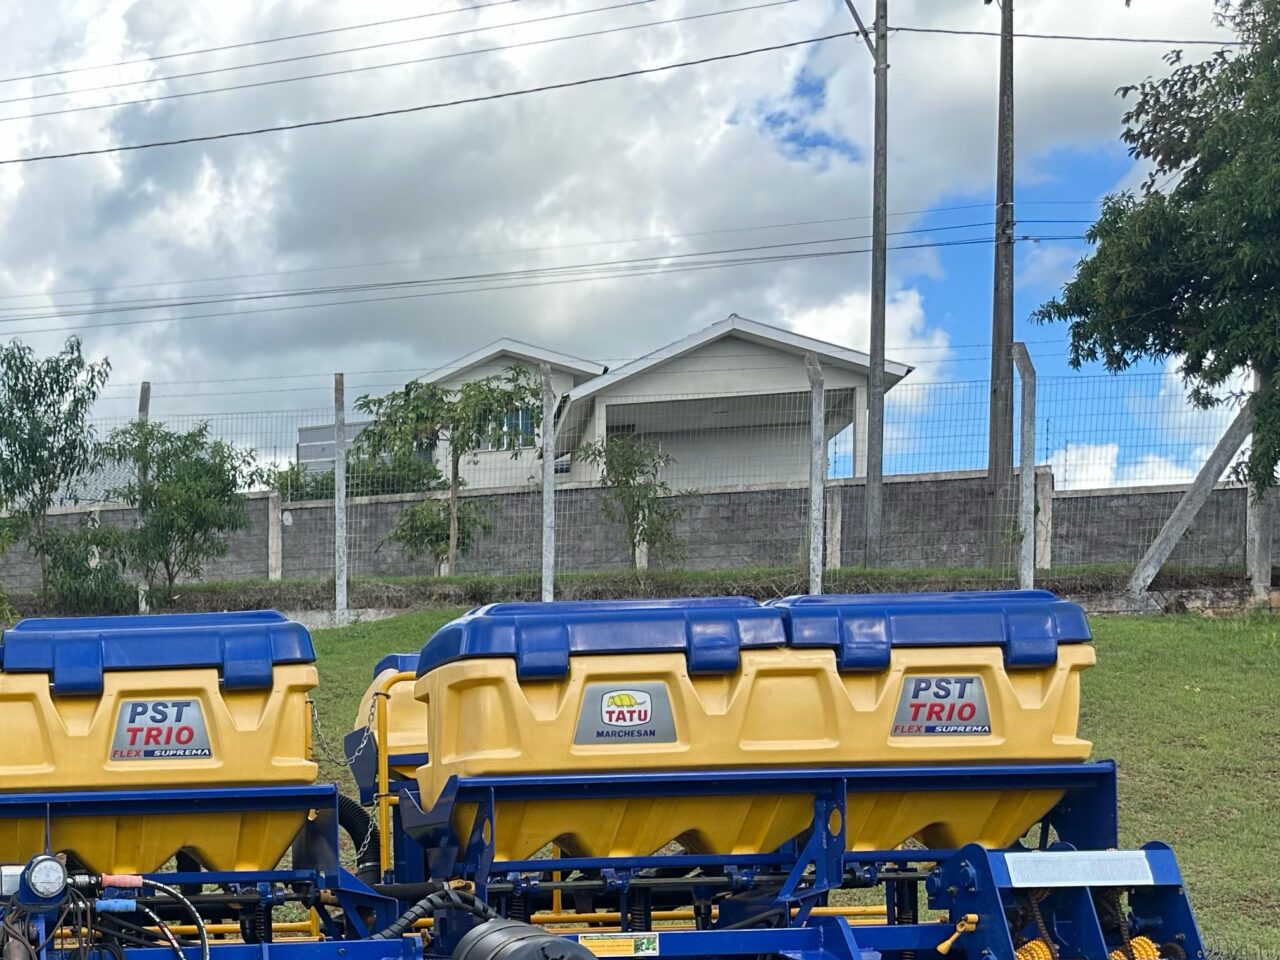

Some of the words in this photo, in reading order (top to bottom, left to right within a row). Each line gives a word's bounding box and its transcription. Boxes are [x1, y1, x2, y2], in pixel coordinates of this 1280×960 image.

[911, 678, 974, 699] PST
[128, 702, 192, 724] PST
[605, 709, 648, 722] TATU
[909, 702, 977, 722] TRIO
[126, 725, 195, 746] TRIO
[596, 729, 656, 738] MARCHESAN
[893, 725, 923, 733] FLEX
[112, 749, 142, 758] FLEX
[153, 749, 210, 757] SUPREMA
